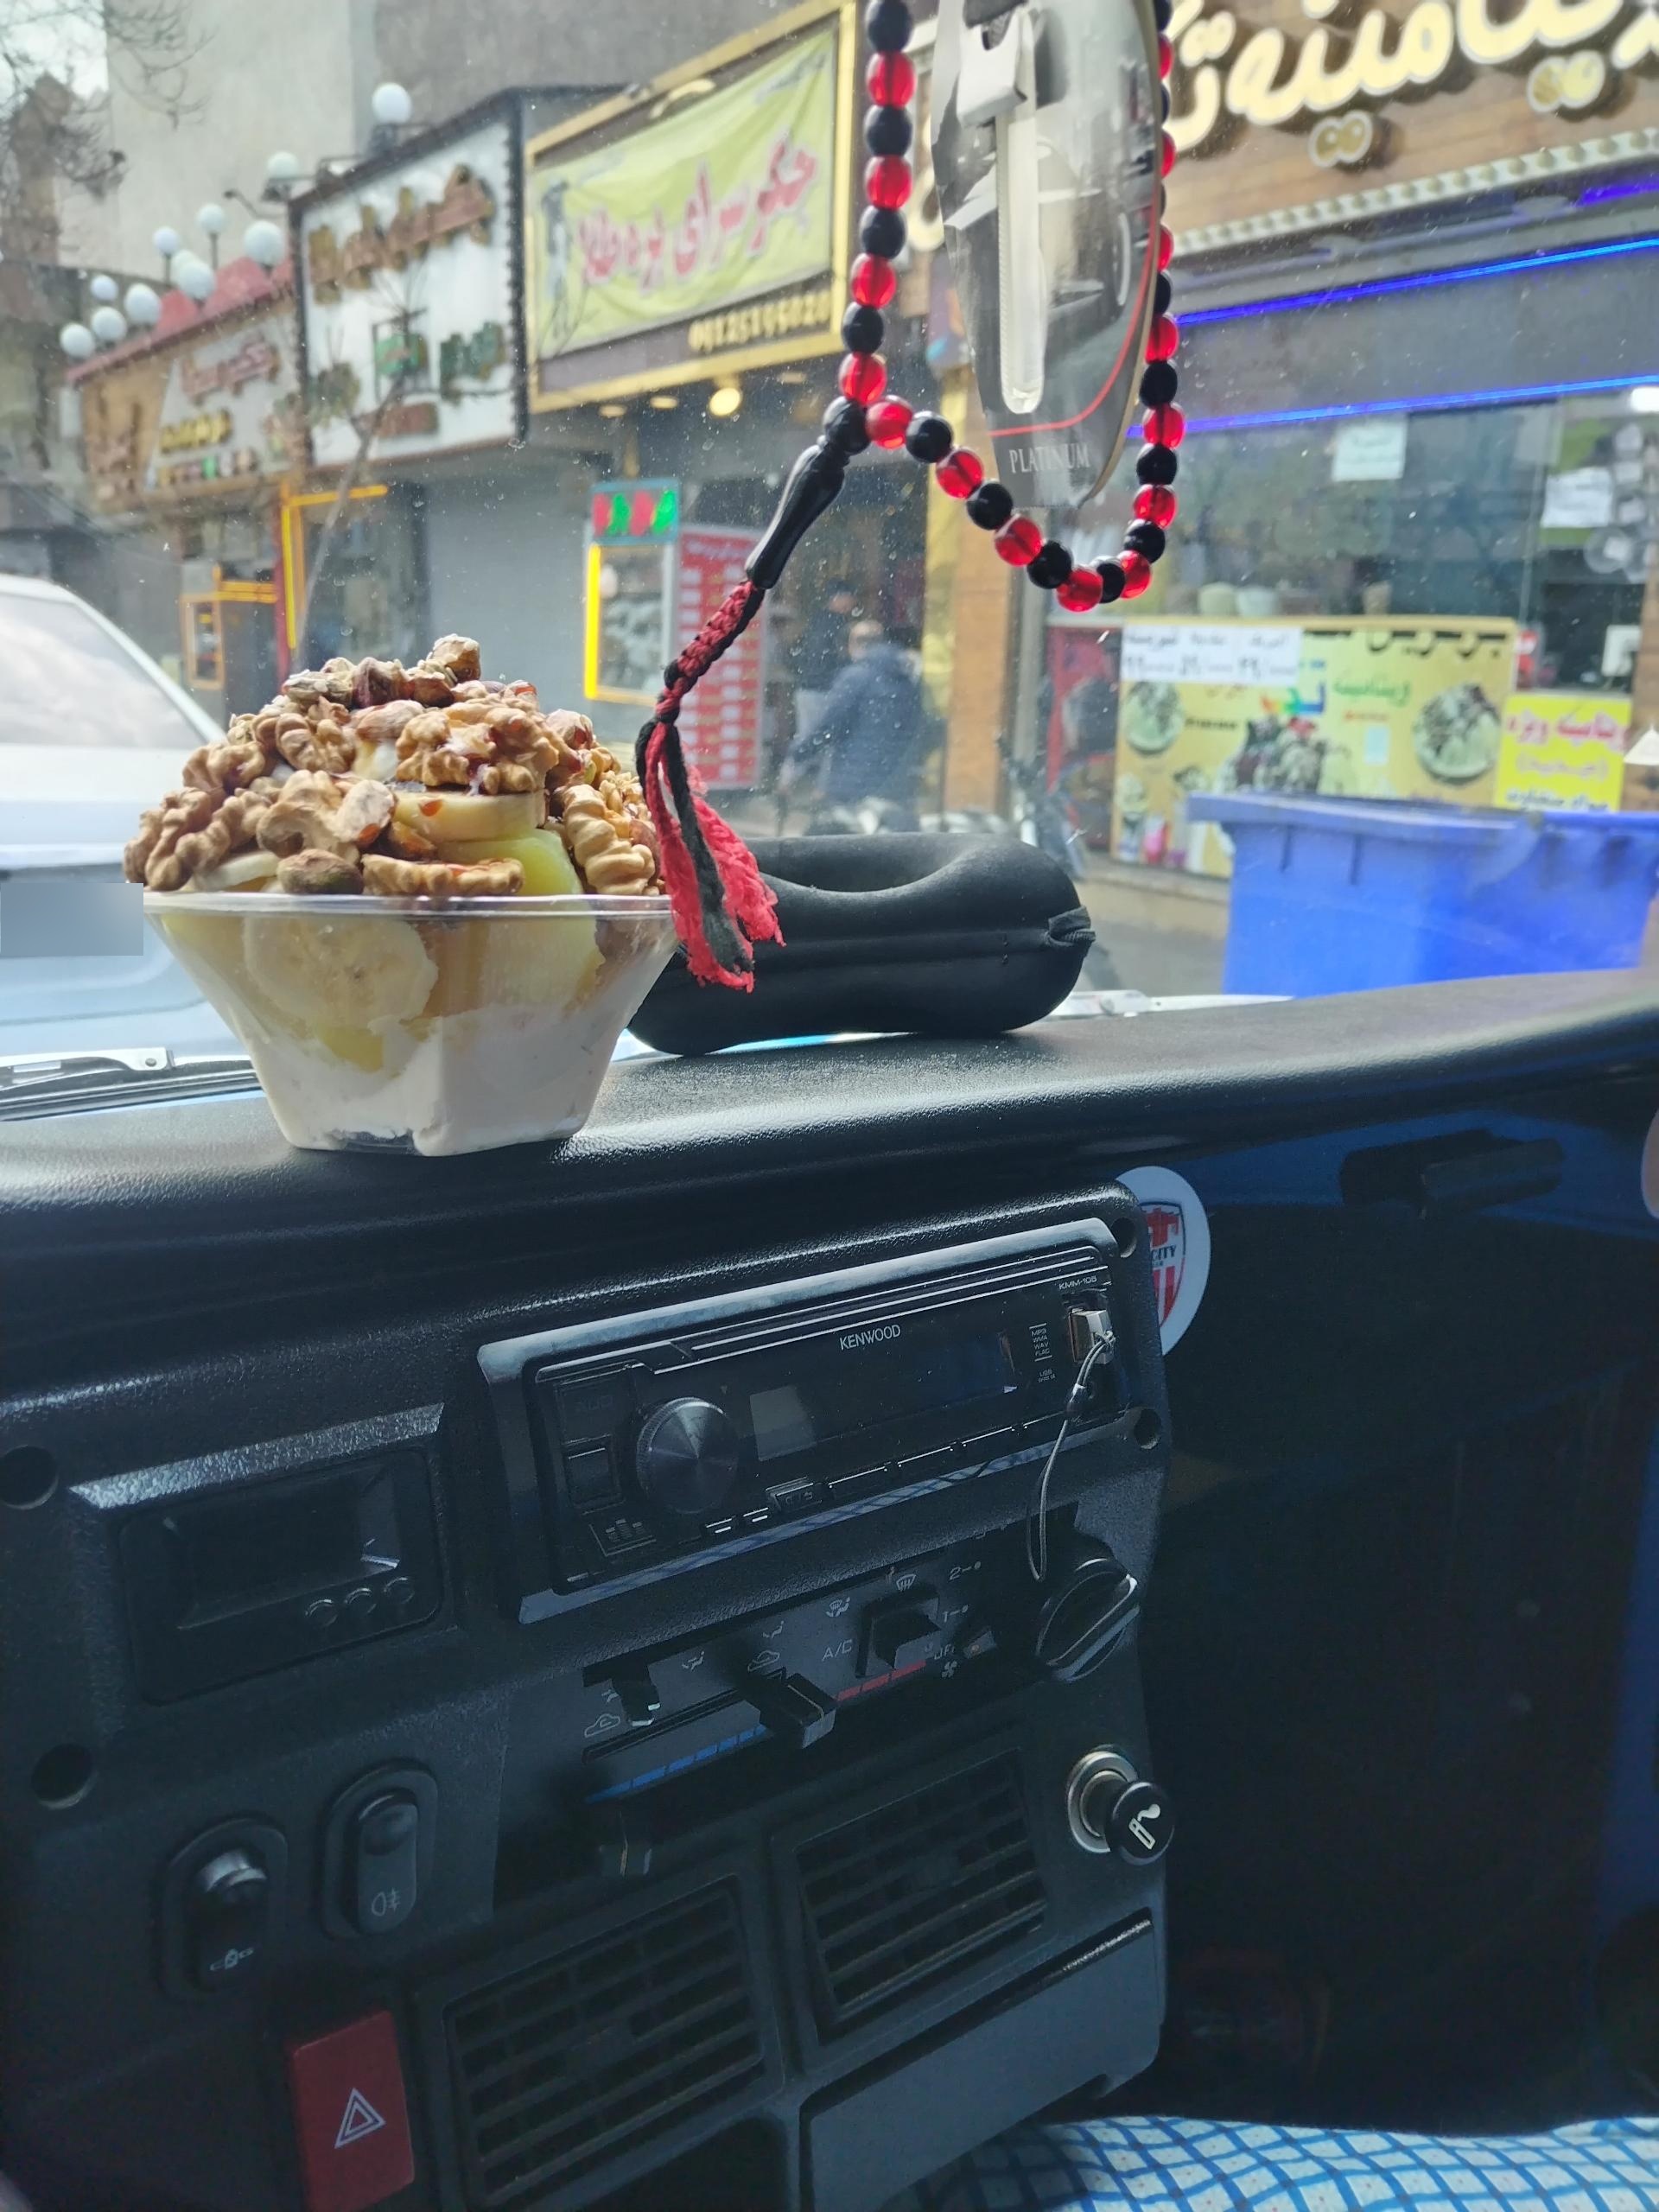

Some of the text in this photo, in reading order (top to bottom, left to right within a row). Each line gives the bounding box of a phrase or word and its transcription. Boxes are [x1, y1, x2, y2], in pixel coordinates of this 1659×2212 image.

[1008, 443, 1091, 474] PLATINUM
[1151, 1245, 1176, 1262] CITY
[839, 1325, 901, 1351] KENWOOD
[822, 1639, 853, 1662] A/C
